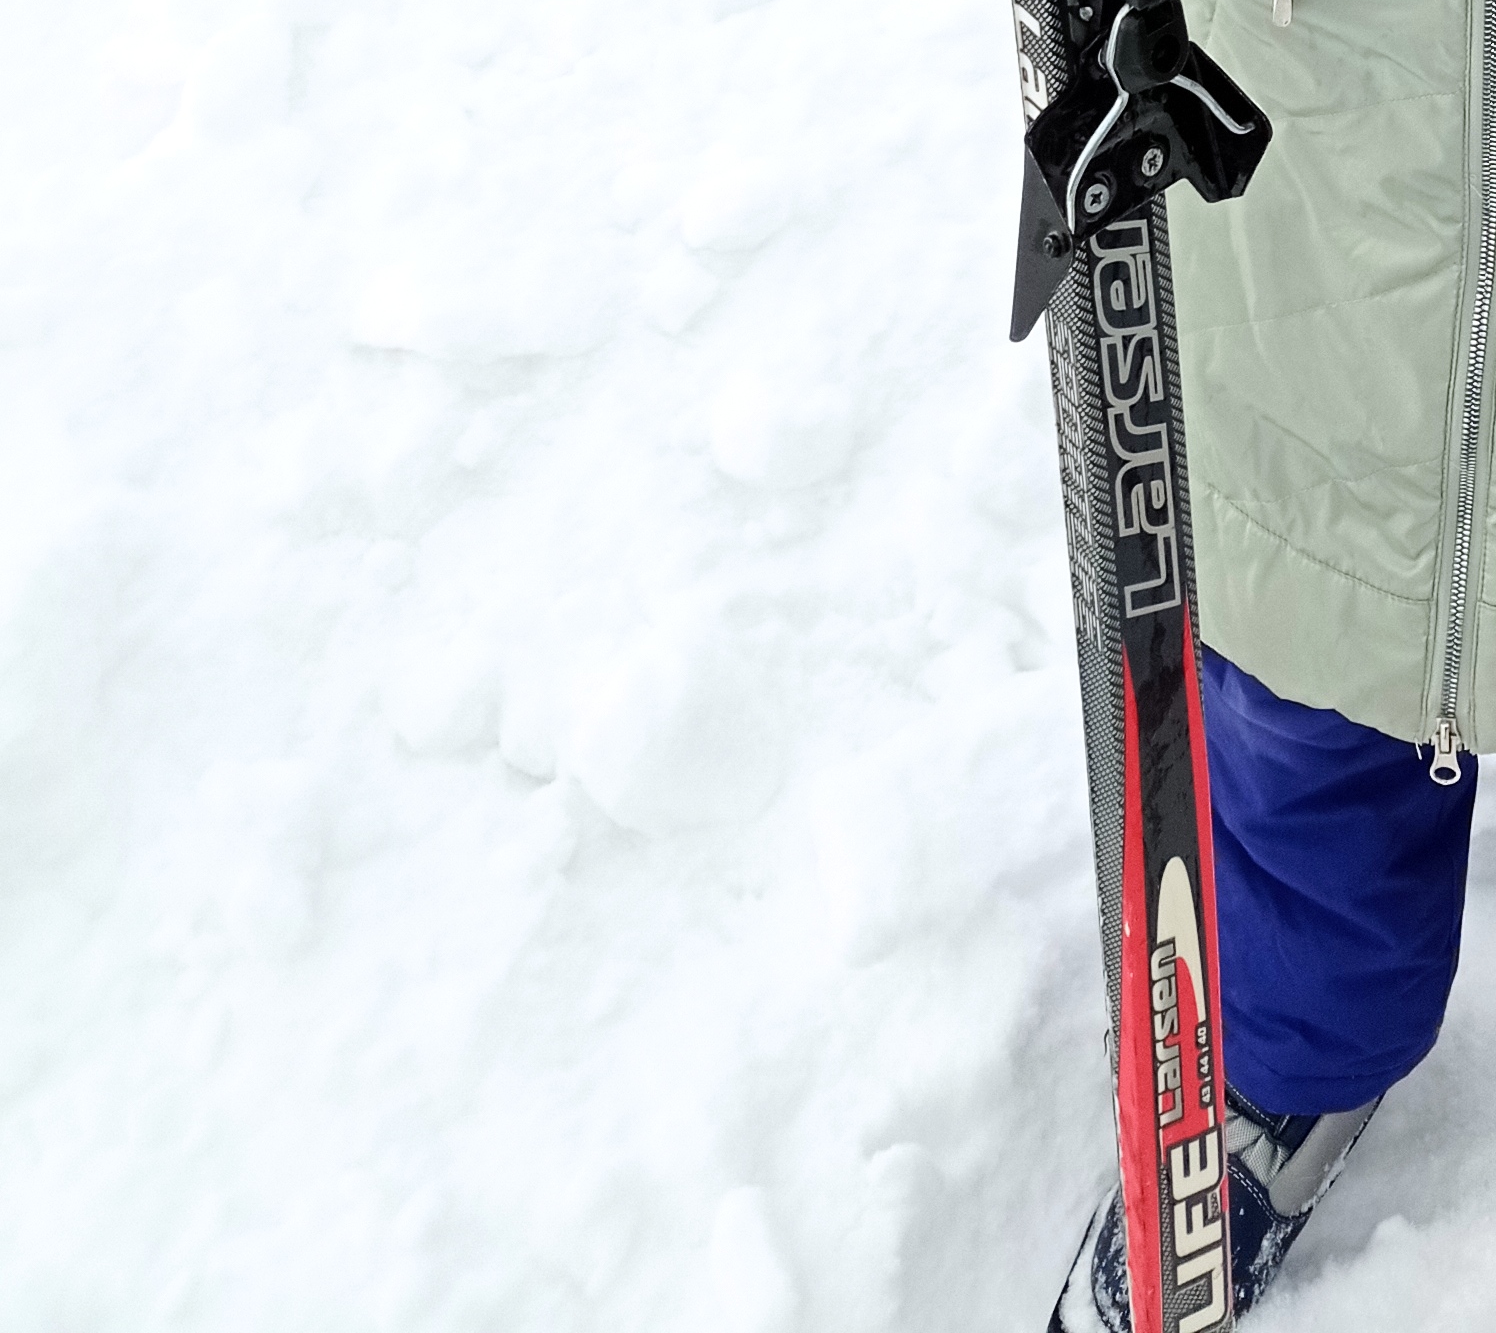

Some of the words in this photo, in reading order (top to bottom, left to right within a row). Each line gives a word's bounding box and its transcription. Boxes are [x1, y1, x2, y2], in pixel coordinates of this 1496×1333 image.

[1151, 939, 1182, 1126] Larsen
[1197, 1027, 1207, 1044] 40
[1199, 1056, 1209, 1074] 44
[1201, 1086, 1211, 1103] 43
